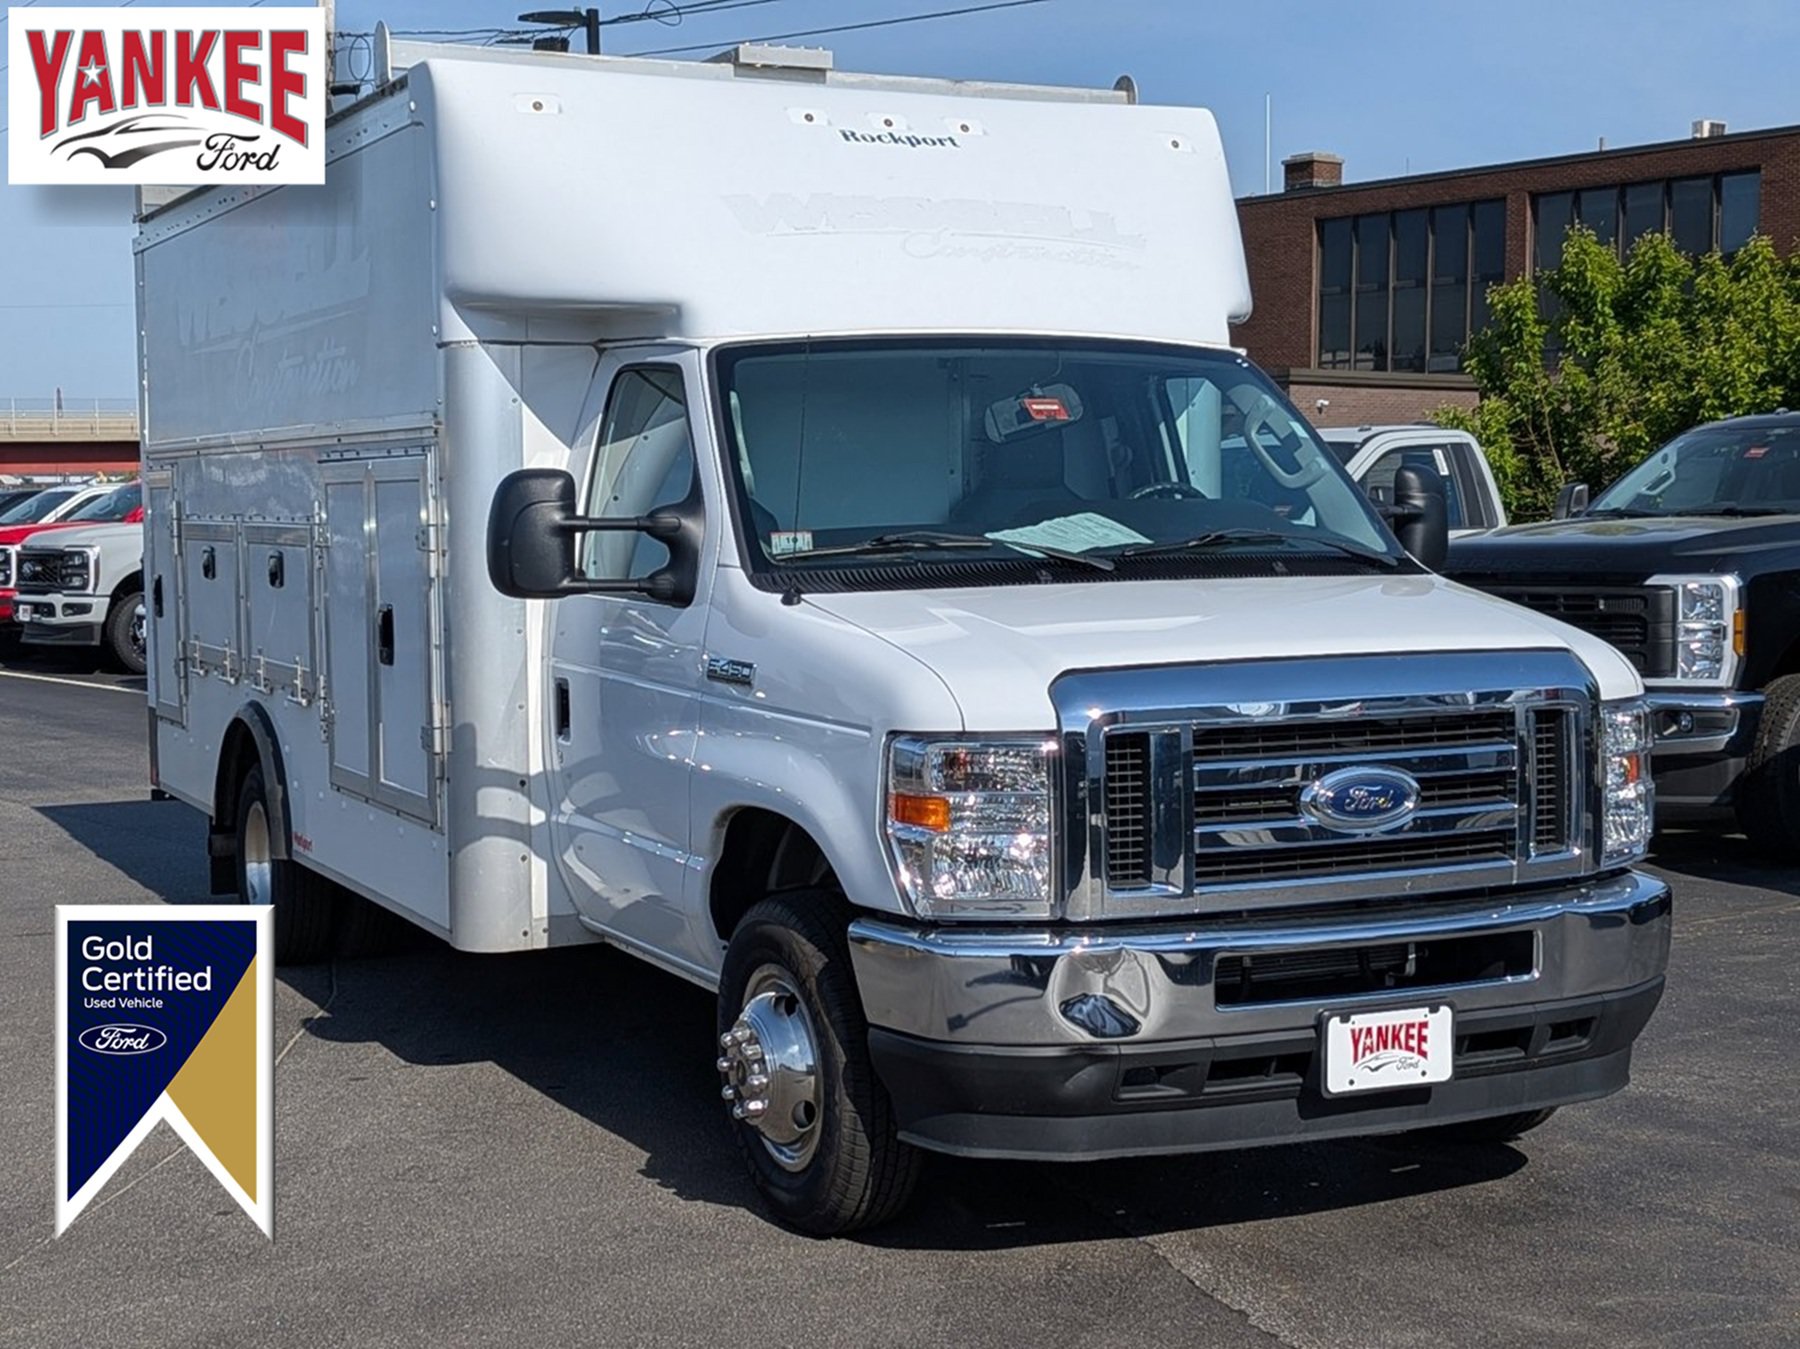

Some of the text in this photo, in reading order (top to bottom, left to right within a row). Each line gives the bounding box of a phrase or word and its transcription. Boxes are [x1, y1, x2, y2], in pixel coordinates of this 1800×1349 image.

[839, 129, 961, 148] Rockport
[1344, 785, 1394, 811] Ford
[1350, 1021, 1429, 1066] YANKEE
[1396, 1056, 1421, 1071] Ford
